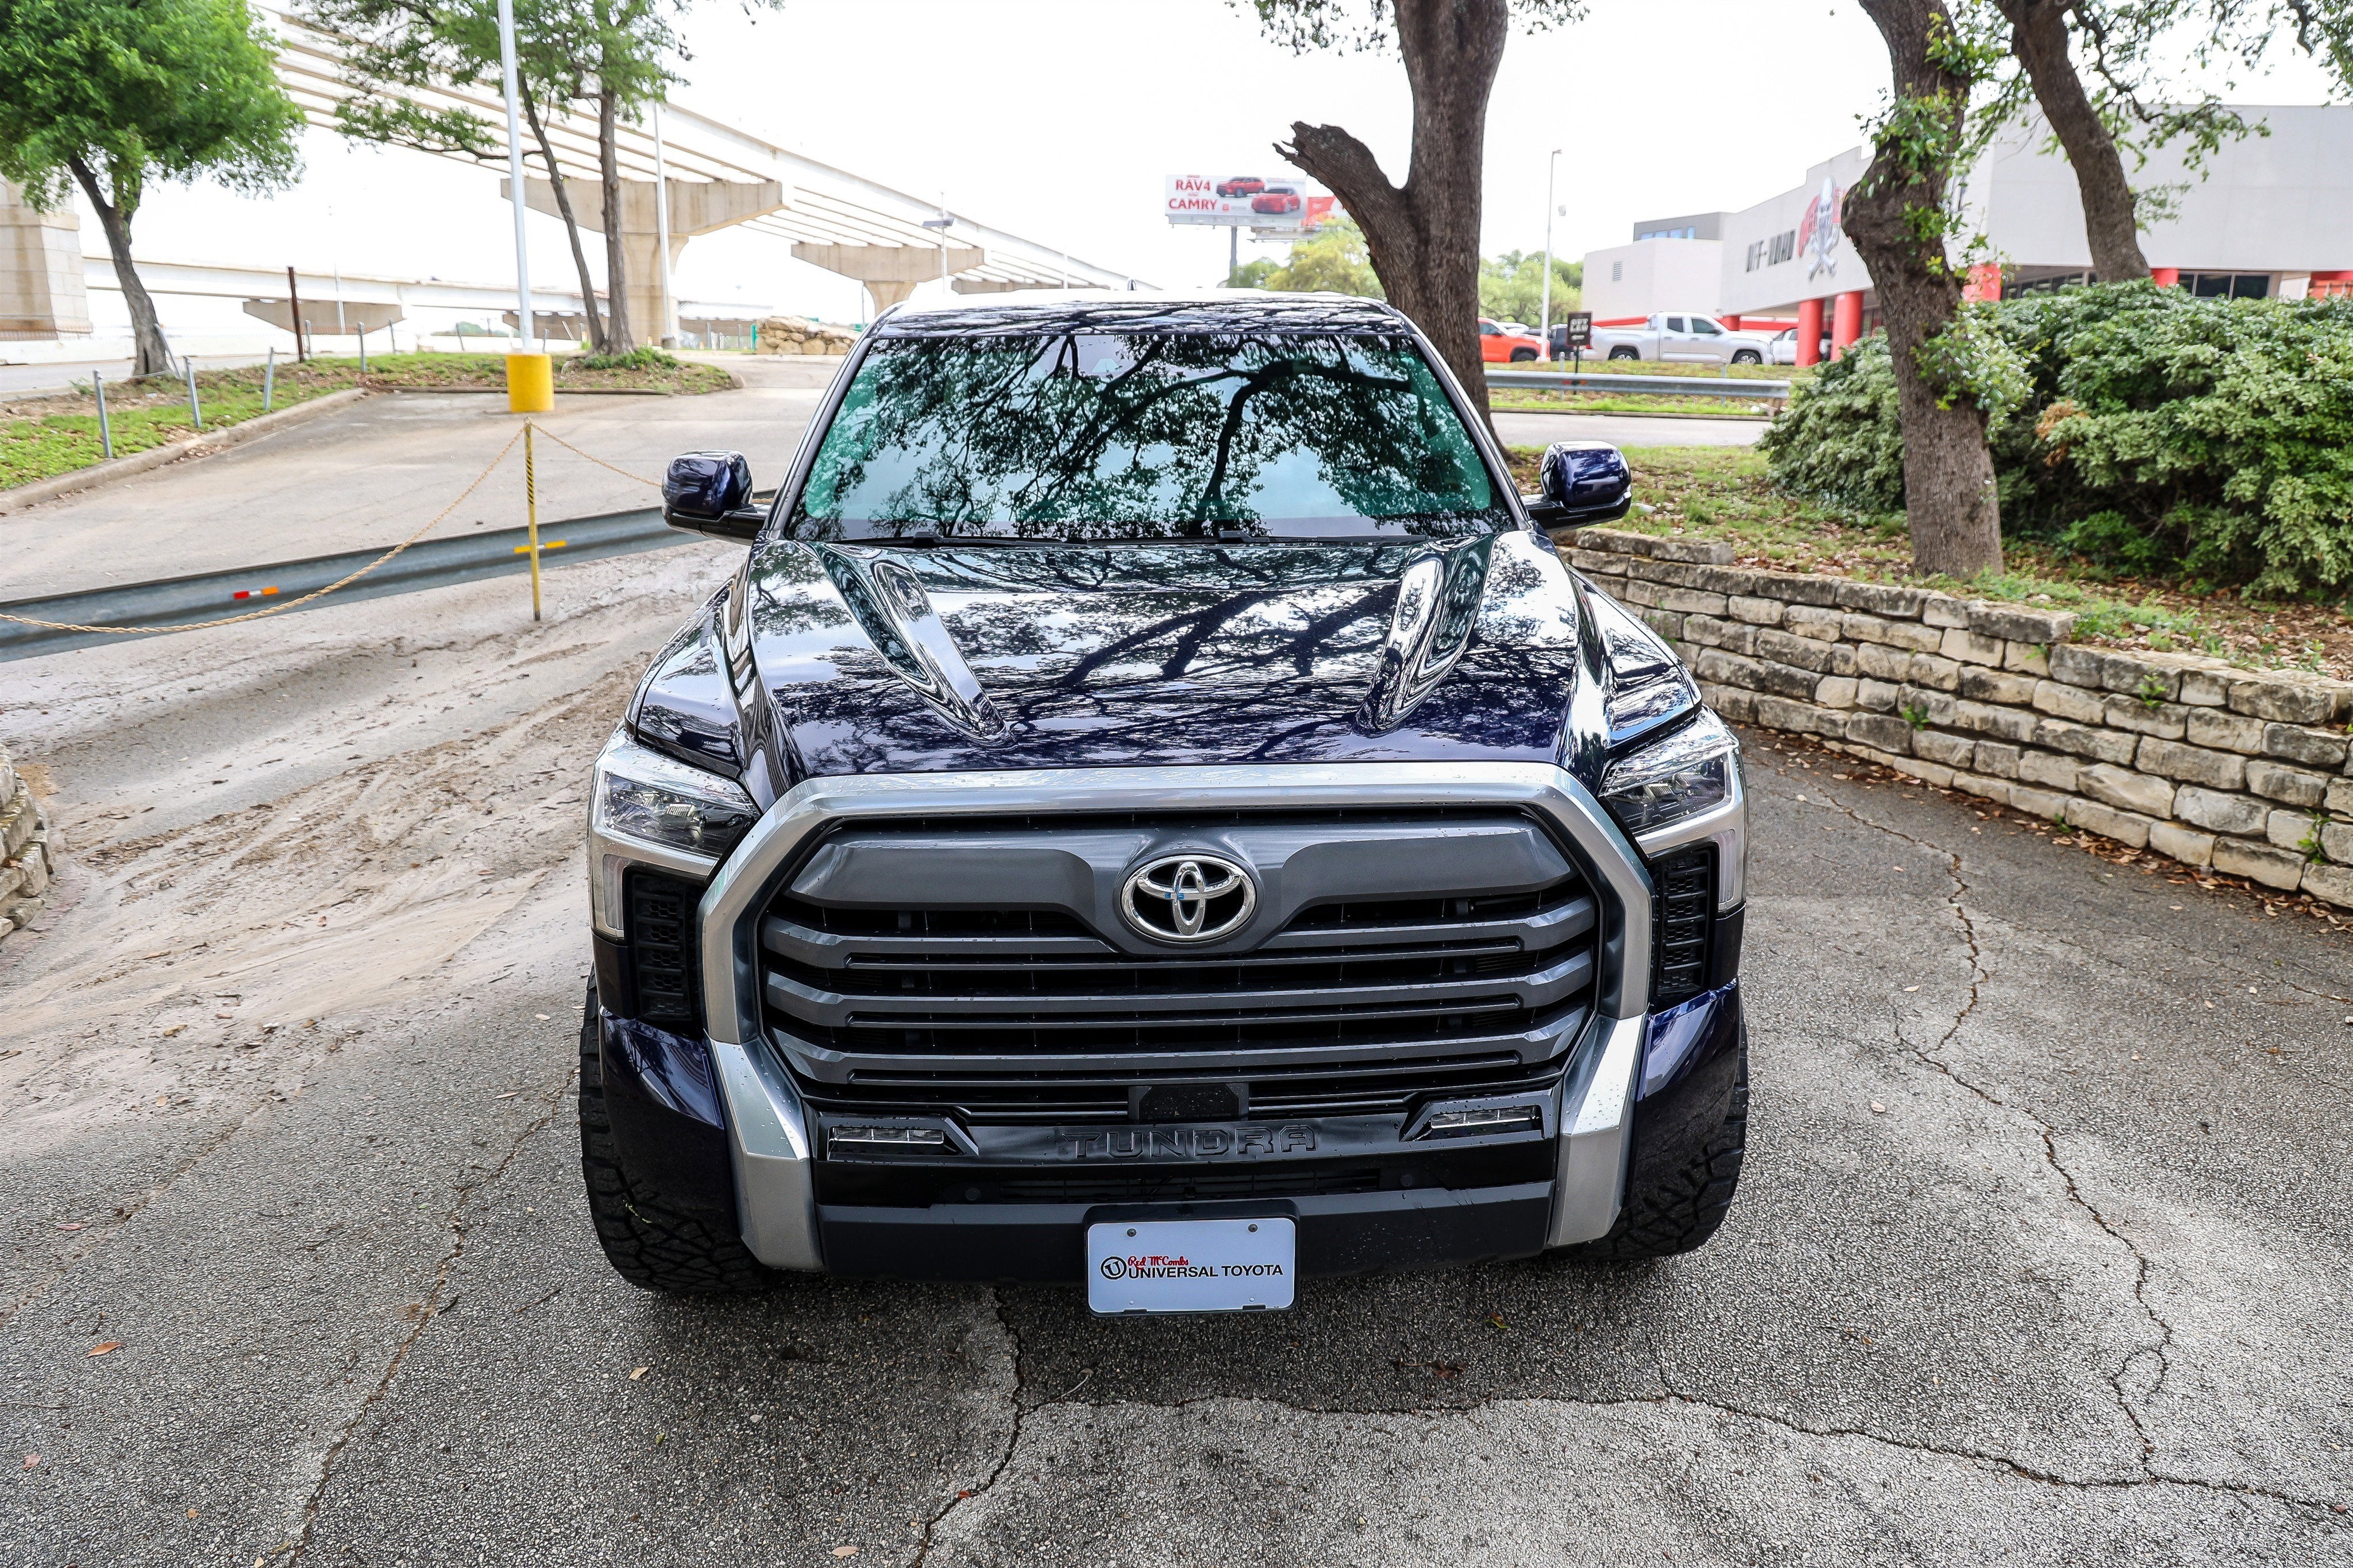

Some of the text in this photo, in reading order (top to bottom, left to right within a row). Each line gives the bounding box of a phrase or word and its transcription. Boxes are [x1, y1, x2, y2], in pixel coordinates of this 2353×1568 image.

[1176, 179, 1211, 191] RAV4
[1168, 198, 1217, 210] CAMRY
[1062, 1125, 1317, 1159] TUNDRA
[1128, 1256, 1189, 1270] Red McCombs
[1128, 1264, 1283, 1279] UNIVERSAL TOYOTA
